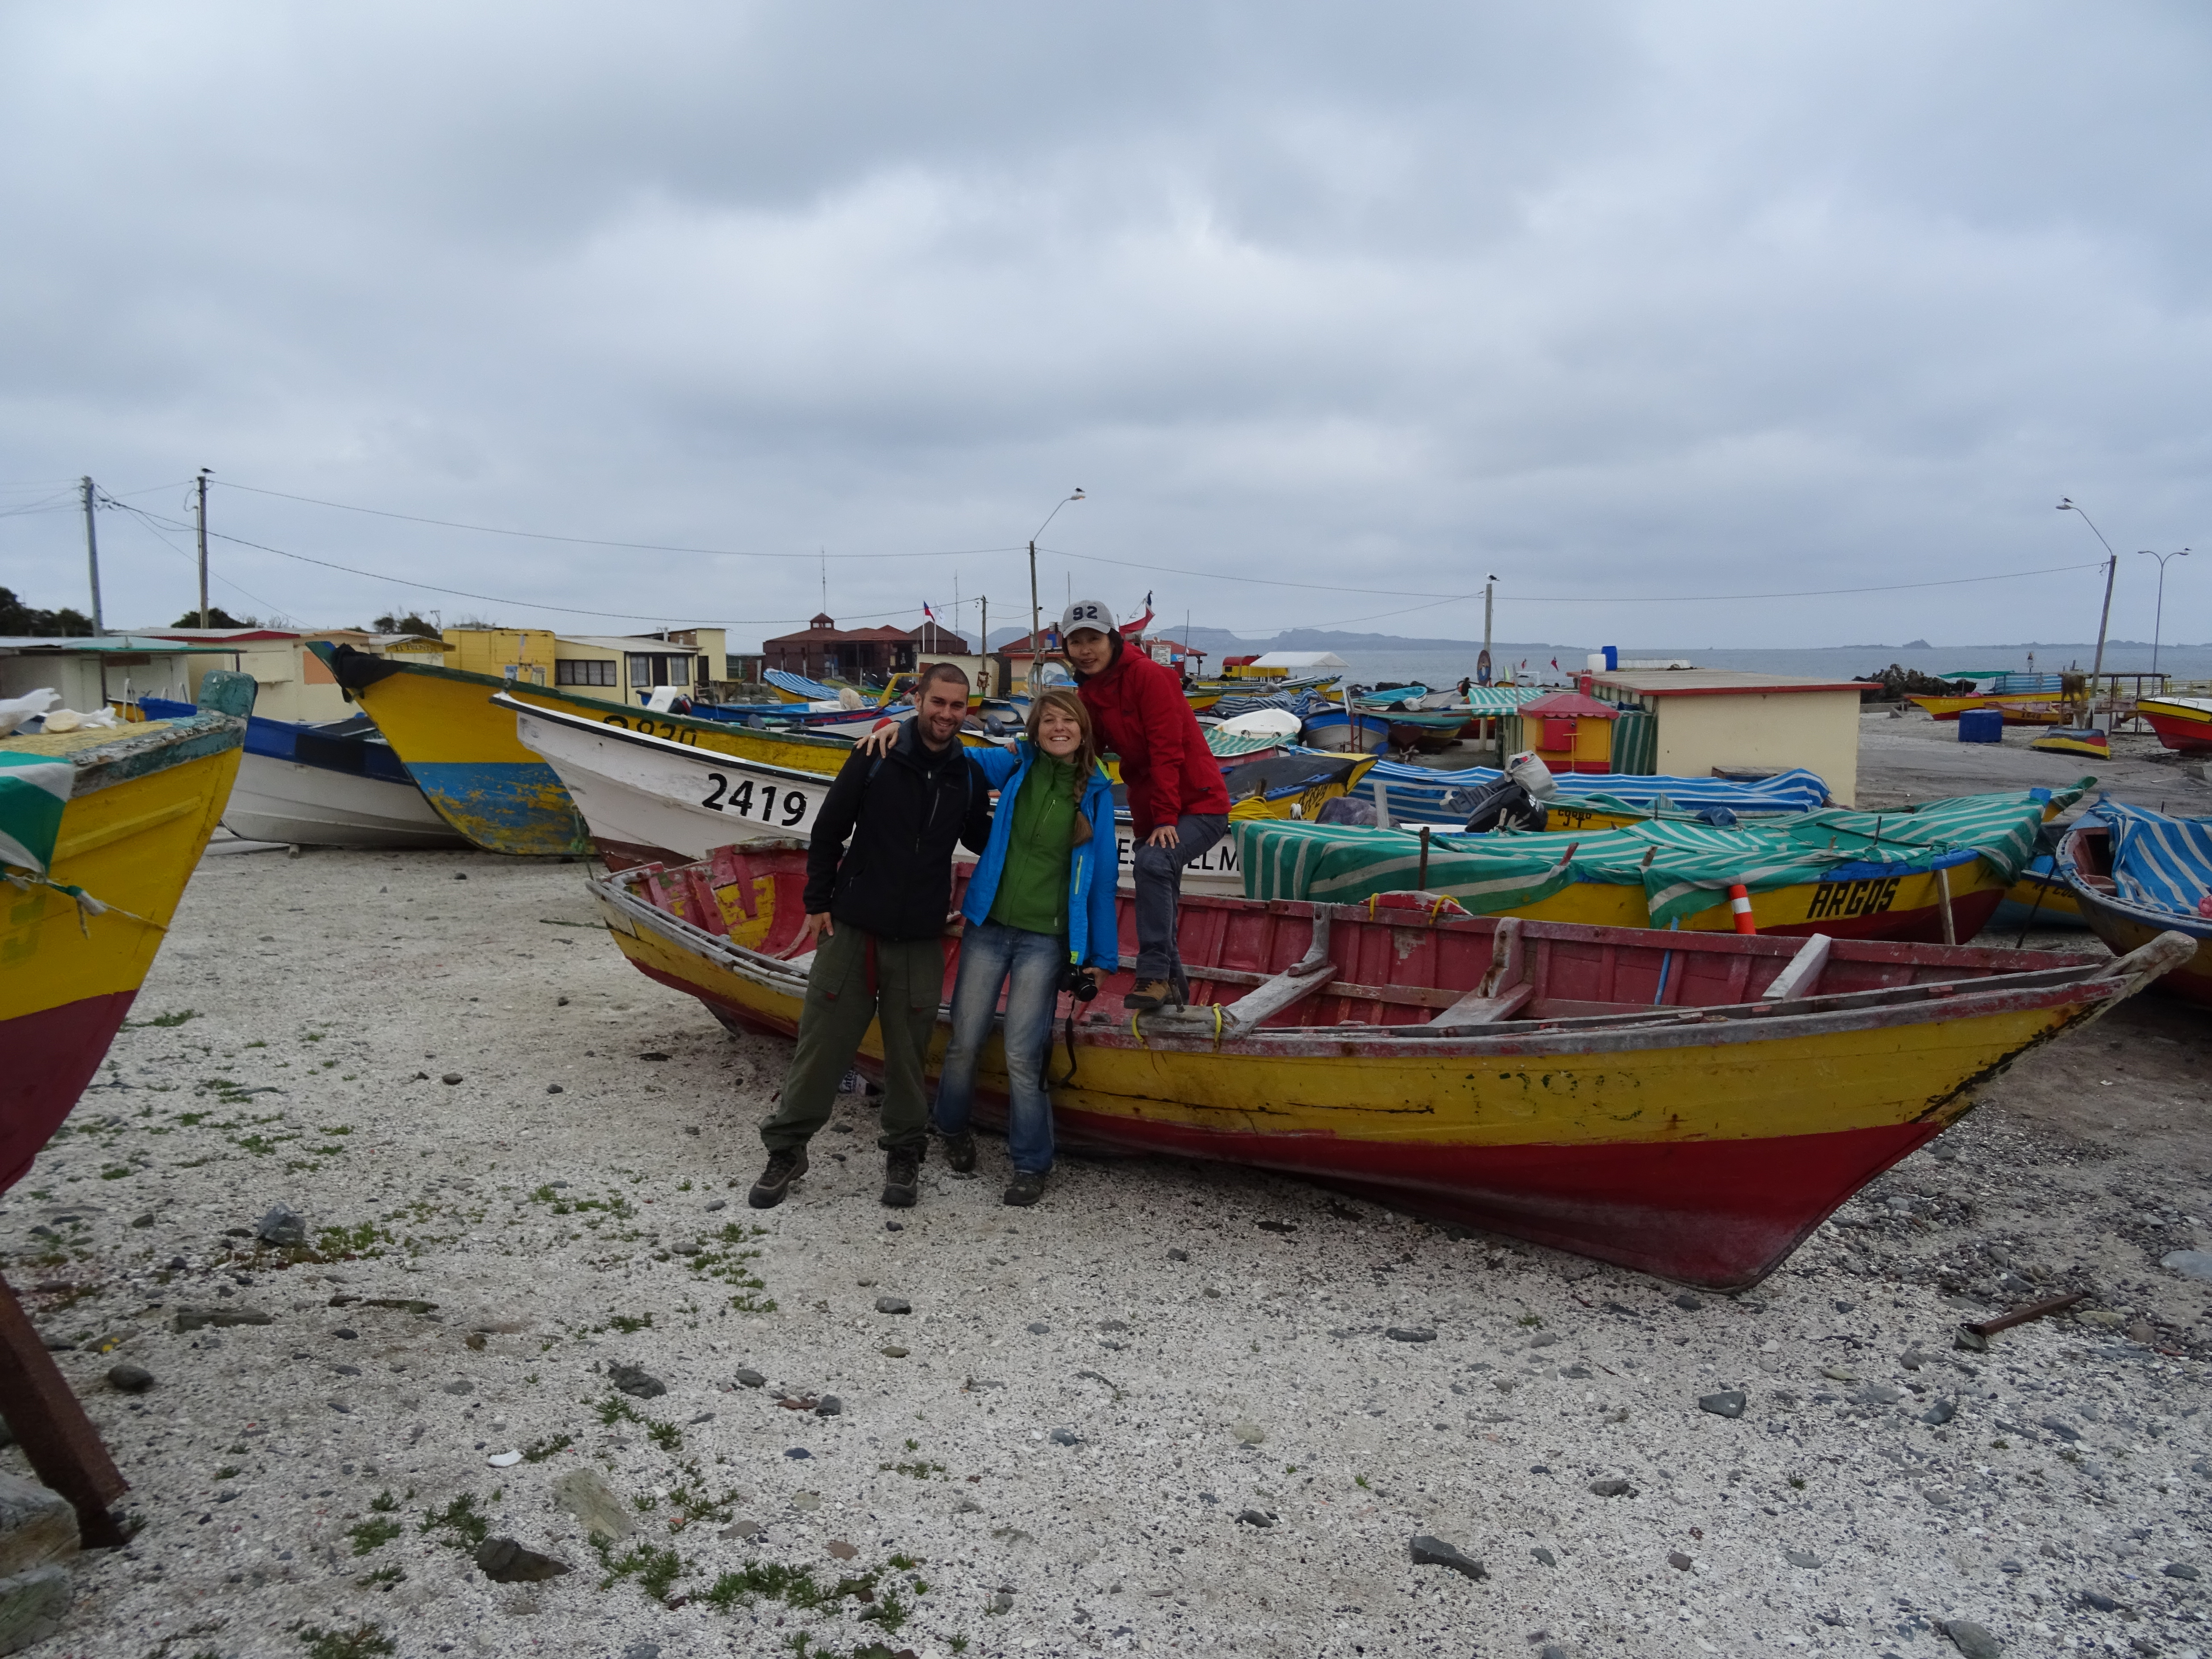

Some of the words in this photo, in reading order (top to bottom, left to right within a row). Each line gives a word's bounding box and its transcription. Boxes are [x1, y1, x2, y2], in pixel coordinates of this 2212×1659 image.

[1073, 606, 1098, 621] 92
[702, 773, 808, 827] 2419
[1525, 794, 1537, 808] 40
[1806, 877, 1901, 919] ARGOS
